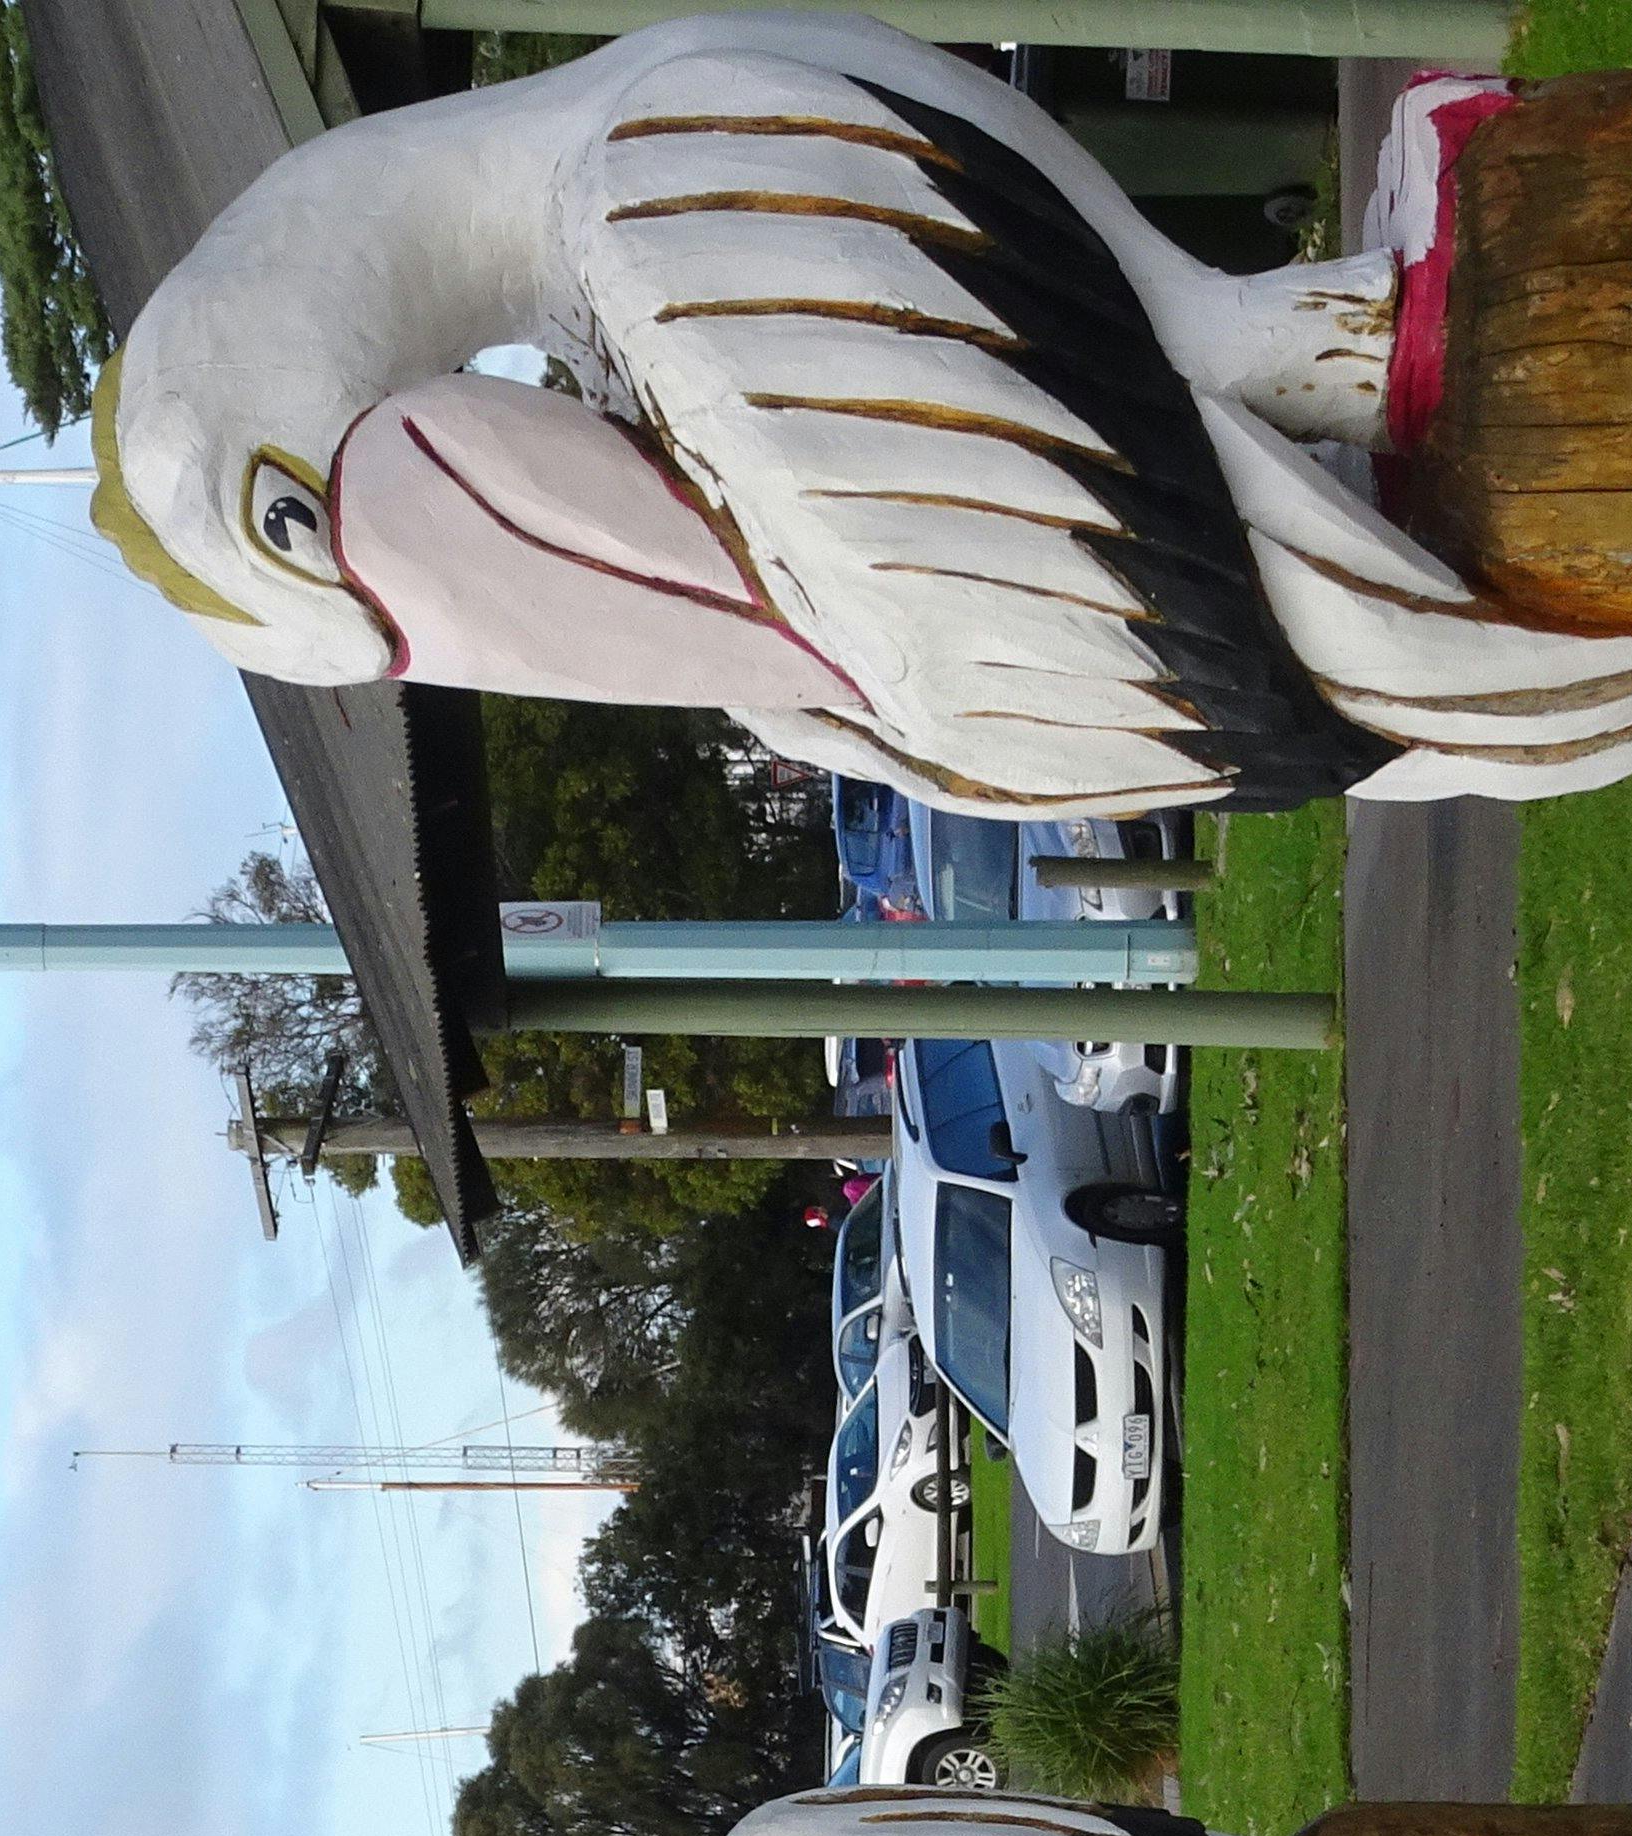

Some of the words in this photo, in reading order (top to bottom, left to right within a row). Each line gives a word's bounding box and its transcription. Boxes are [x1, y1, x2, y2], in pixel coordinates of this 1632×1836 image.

[626, 1050, 639, 1062] ST
[1127, 1416, 1143, 1442] 096
[1127, 1451, 1143, 1478] YIG
